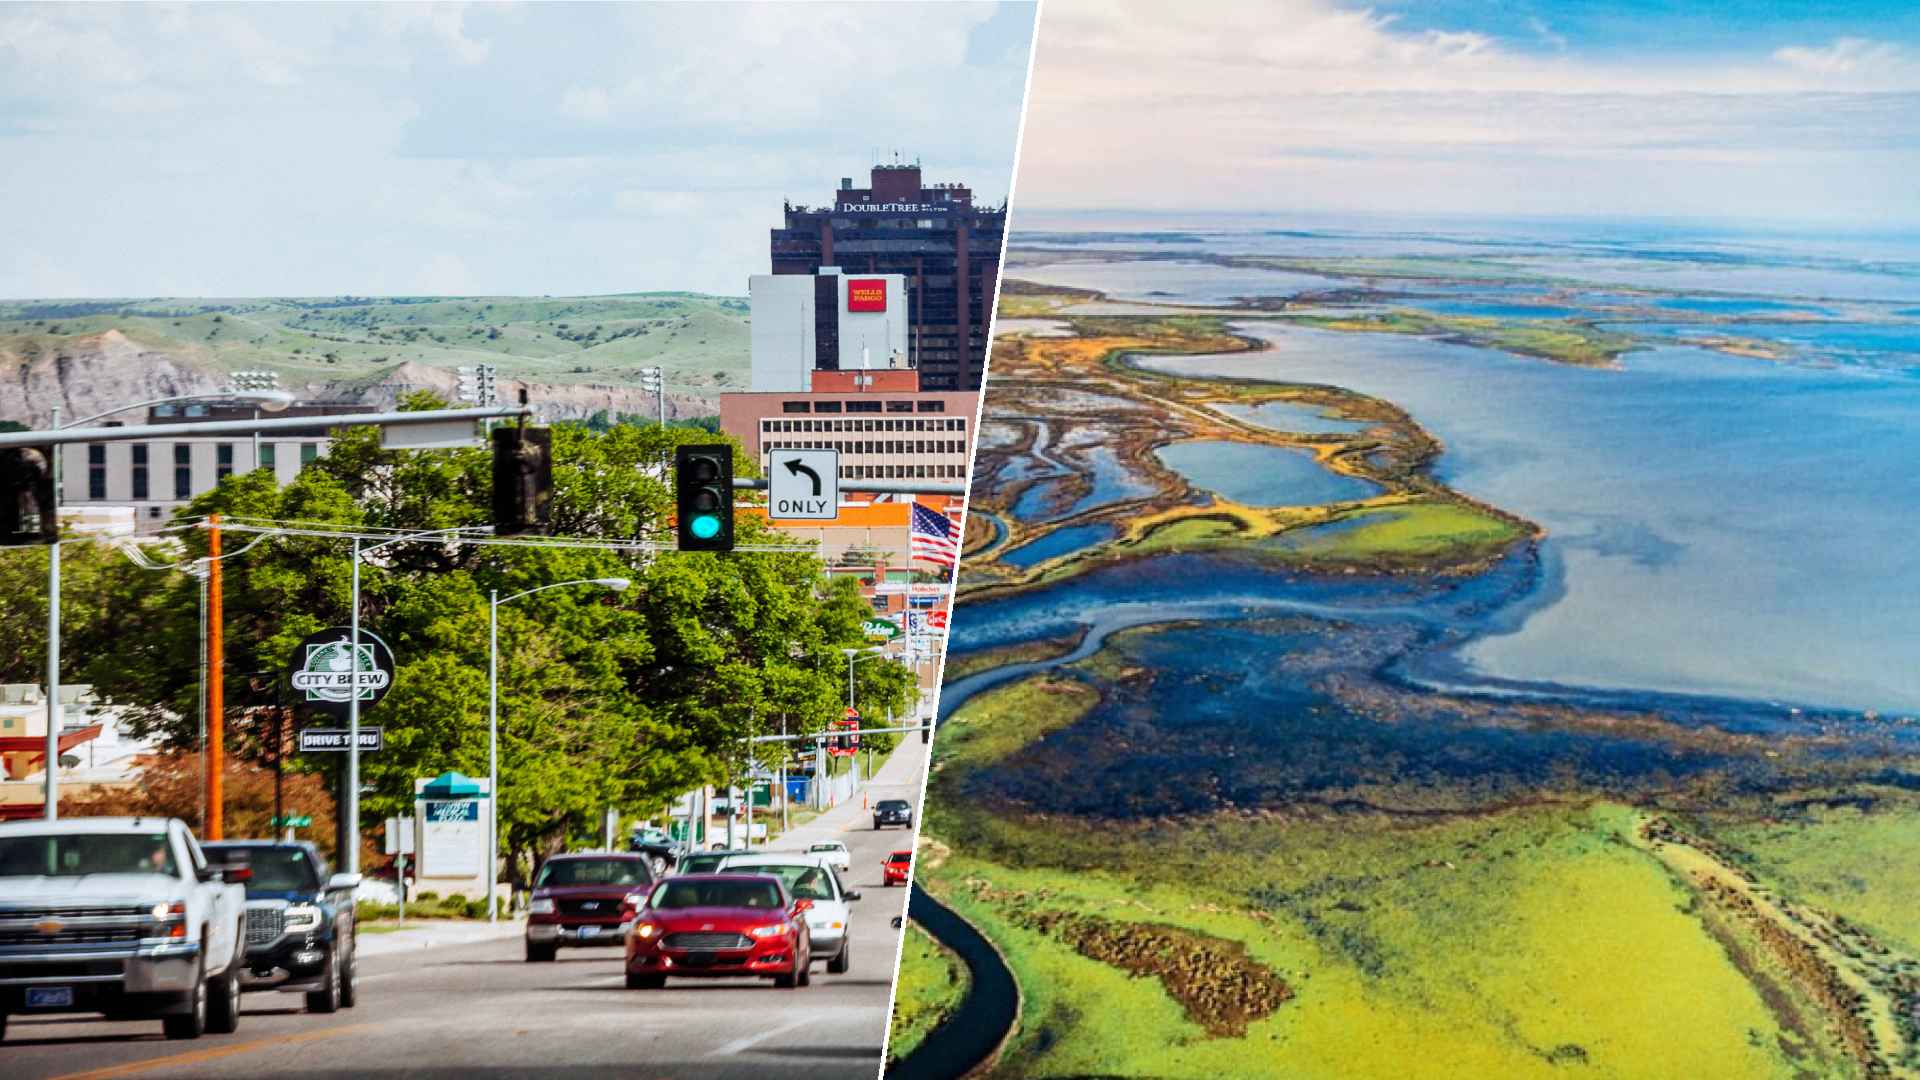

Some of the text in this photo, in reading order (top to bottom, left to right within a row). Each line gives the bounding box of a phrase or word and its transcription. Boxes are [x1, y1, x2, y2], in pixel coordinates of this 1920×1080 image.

[778, 500, 828, 513] ONLY
[297, 674, 332, 685] CITY
[304, 735, 377, 746] DRIVE TRU
